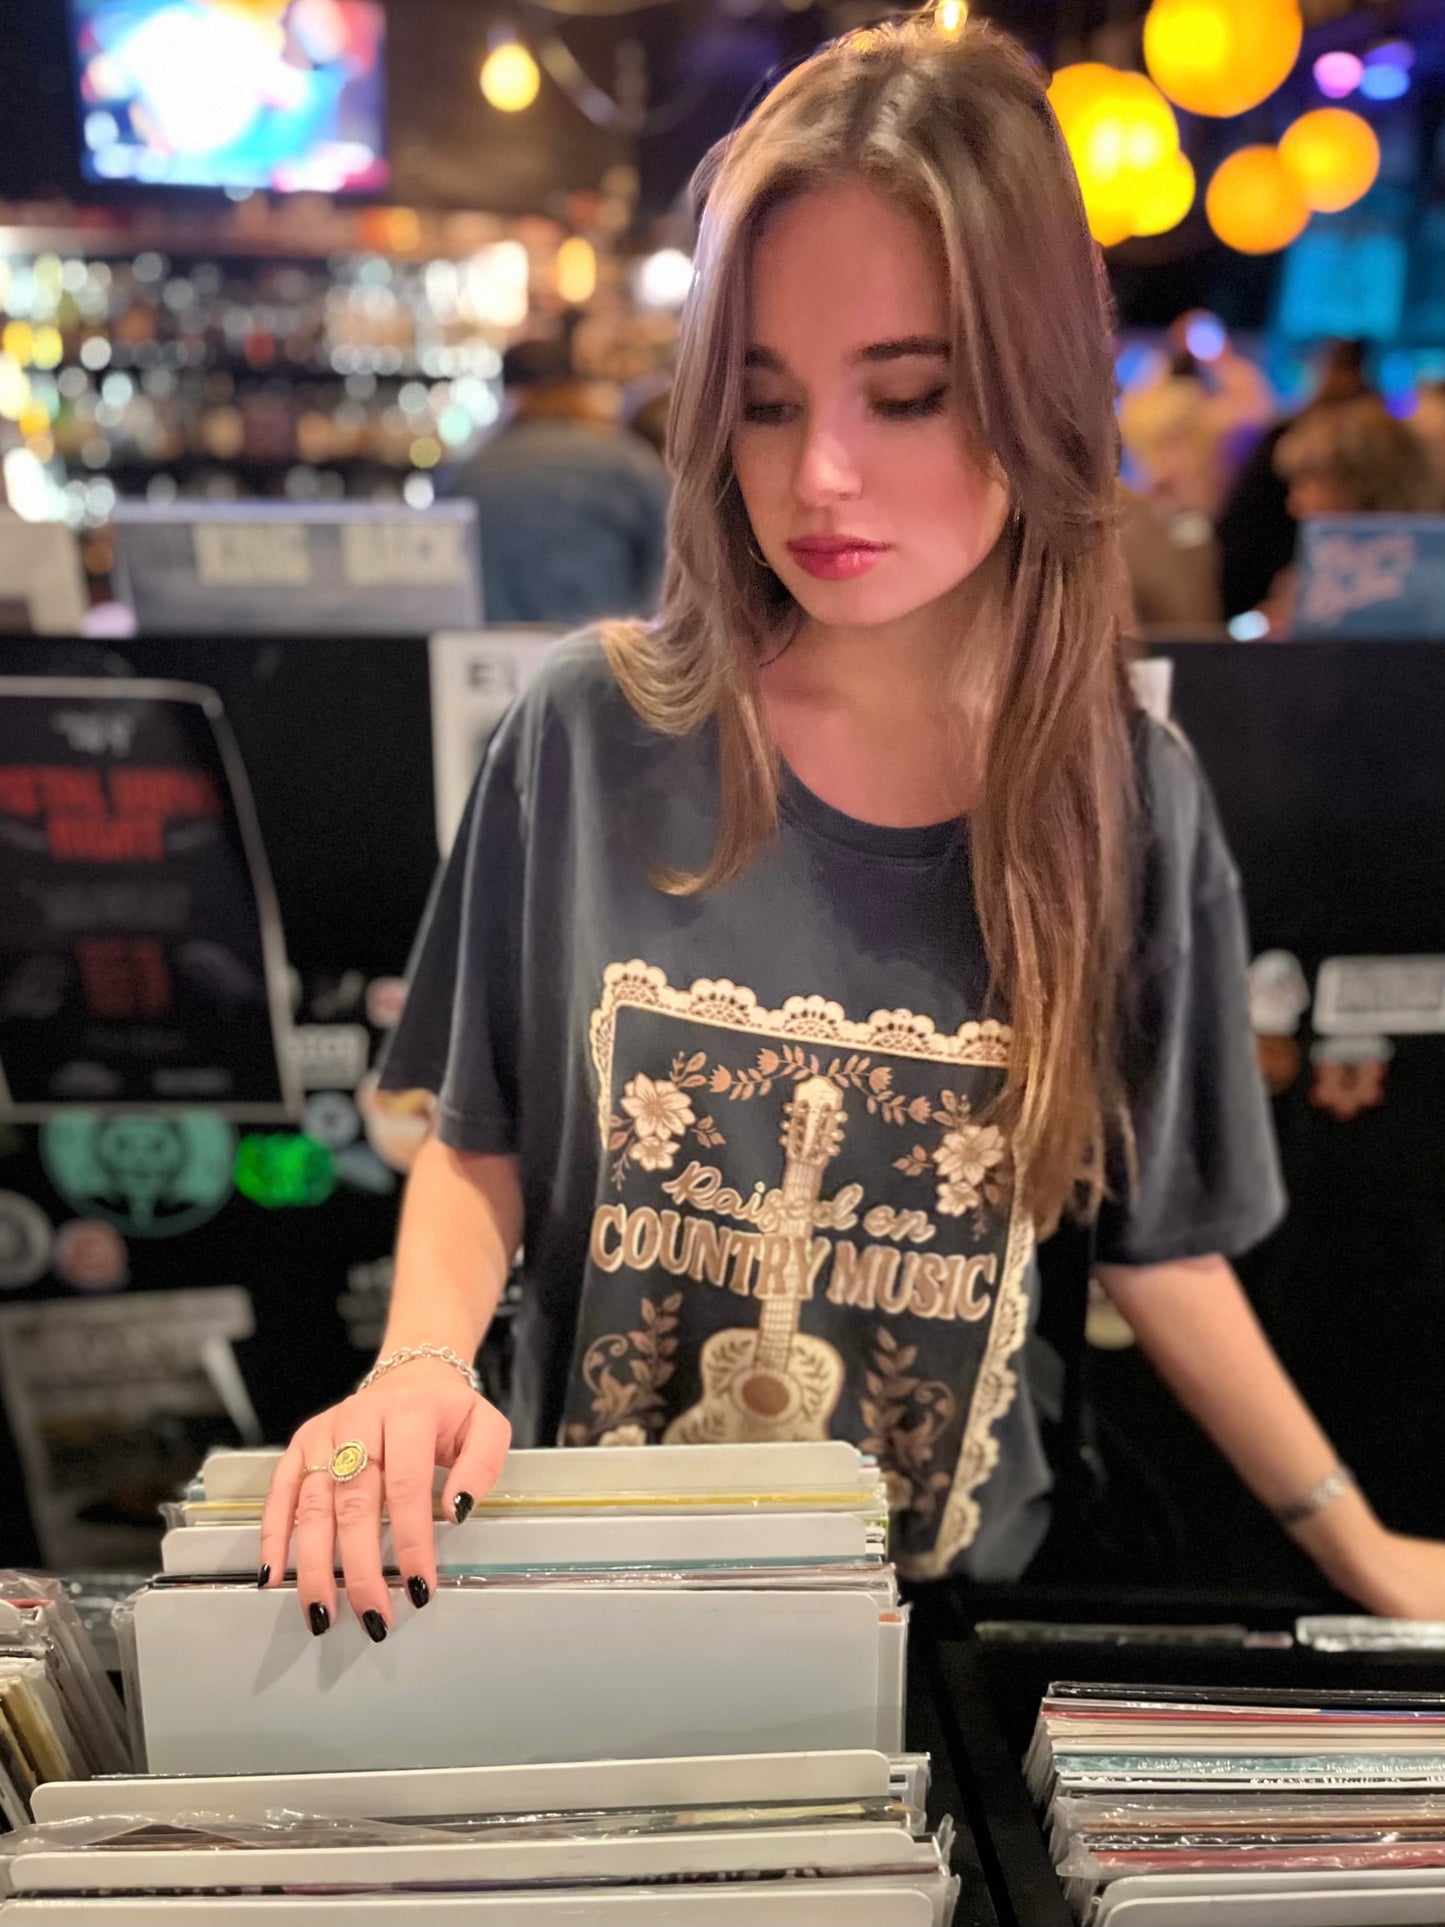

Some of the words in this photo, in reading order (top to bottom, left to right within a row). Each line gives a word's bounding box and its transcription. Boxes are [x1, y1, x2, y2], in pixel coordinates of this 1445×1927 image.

[661, 1160, 864, 1232] Raised
[863, 1205, 936, 1243] on
[590, 1204, 831, 1300] COUNTRY
[826, 1240, 997, 1321] MUSIC
